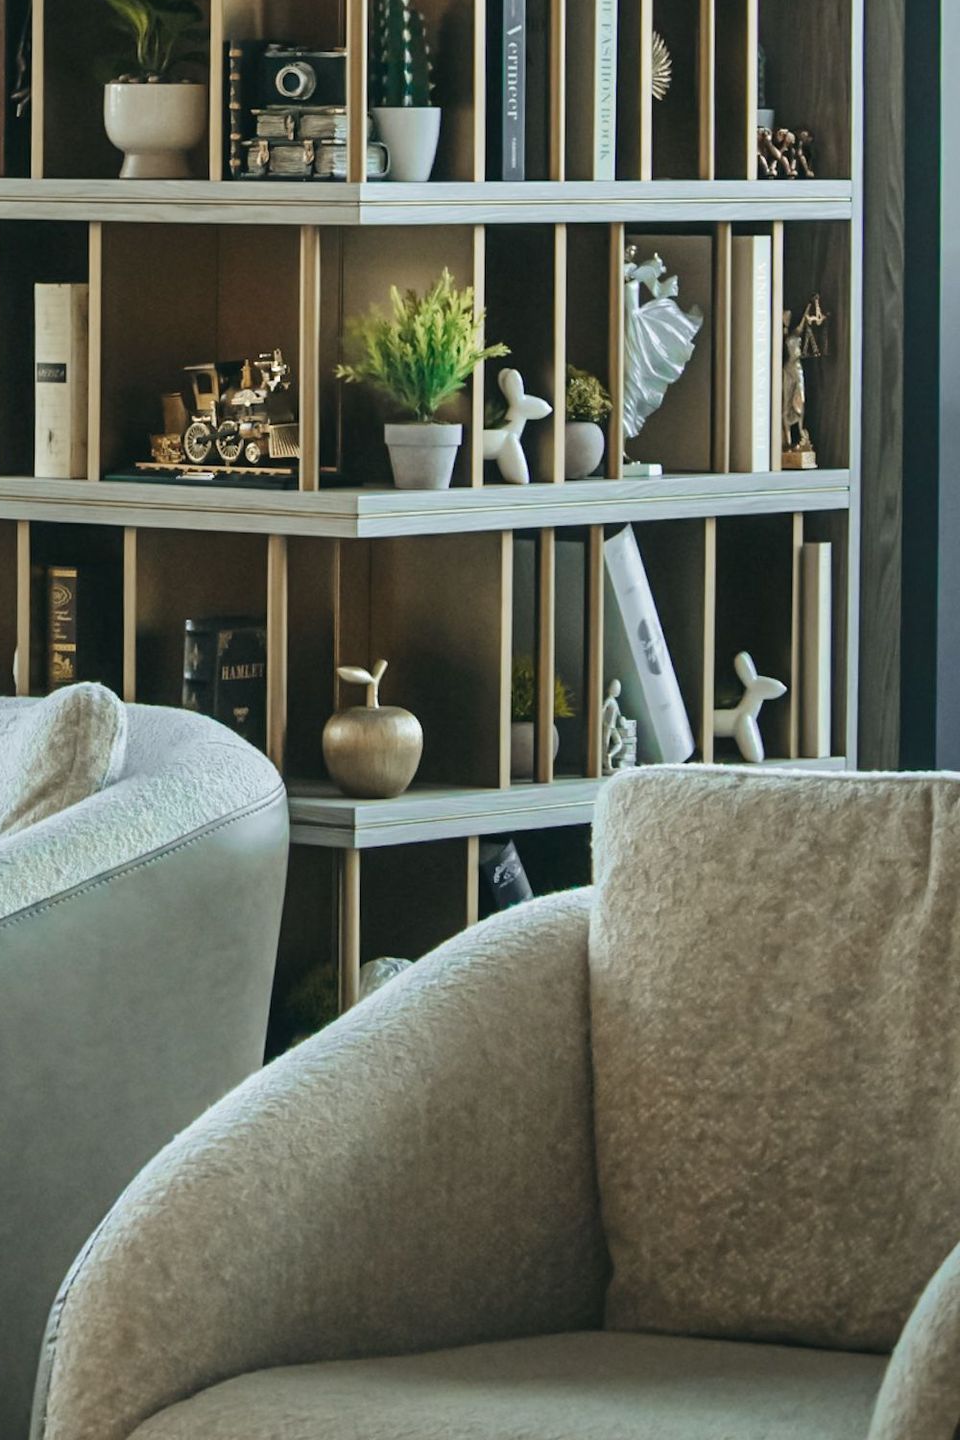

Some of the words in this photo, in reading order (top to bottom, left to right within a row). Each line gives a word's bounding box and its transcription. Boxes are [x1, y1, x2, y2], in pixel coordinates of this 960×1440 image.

[507, 25, 522, 121] Vermeer
[600, 24, 613, 105] FASHION
[600, 108, 611, 160] BOOK
[757, 262, 768, 342] VINCENT
[757, 349, 768, 390] VAN
[222, 663, 265, 680] HAMLET
